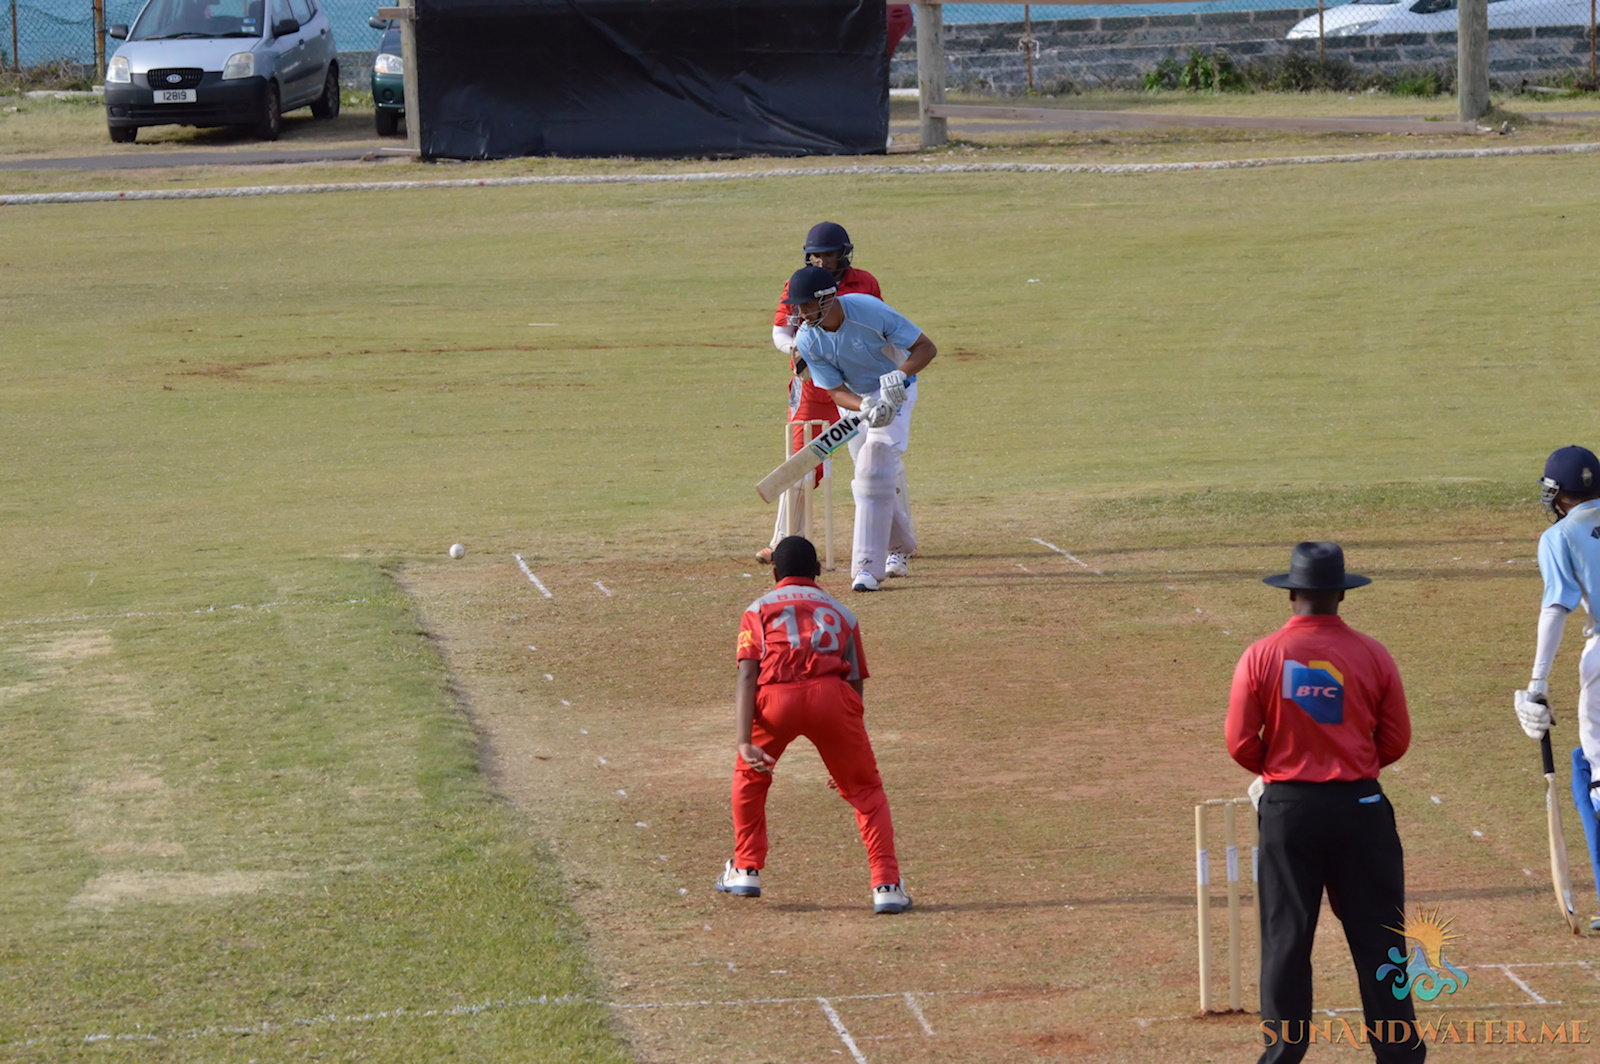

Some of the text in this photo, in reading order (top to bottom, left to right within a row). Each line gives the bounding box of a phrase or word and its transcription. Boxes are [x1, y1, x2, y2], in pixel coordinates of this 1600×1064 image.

[162, 91, 187, 101] 12819
[820, 419, 854, 448] TON
[772, 604, 842, 653] 18
[1296, 685, 1338, 698] BTC
